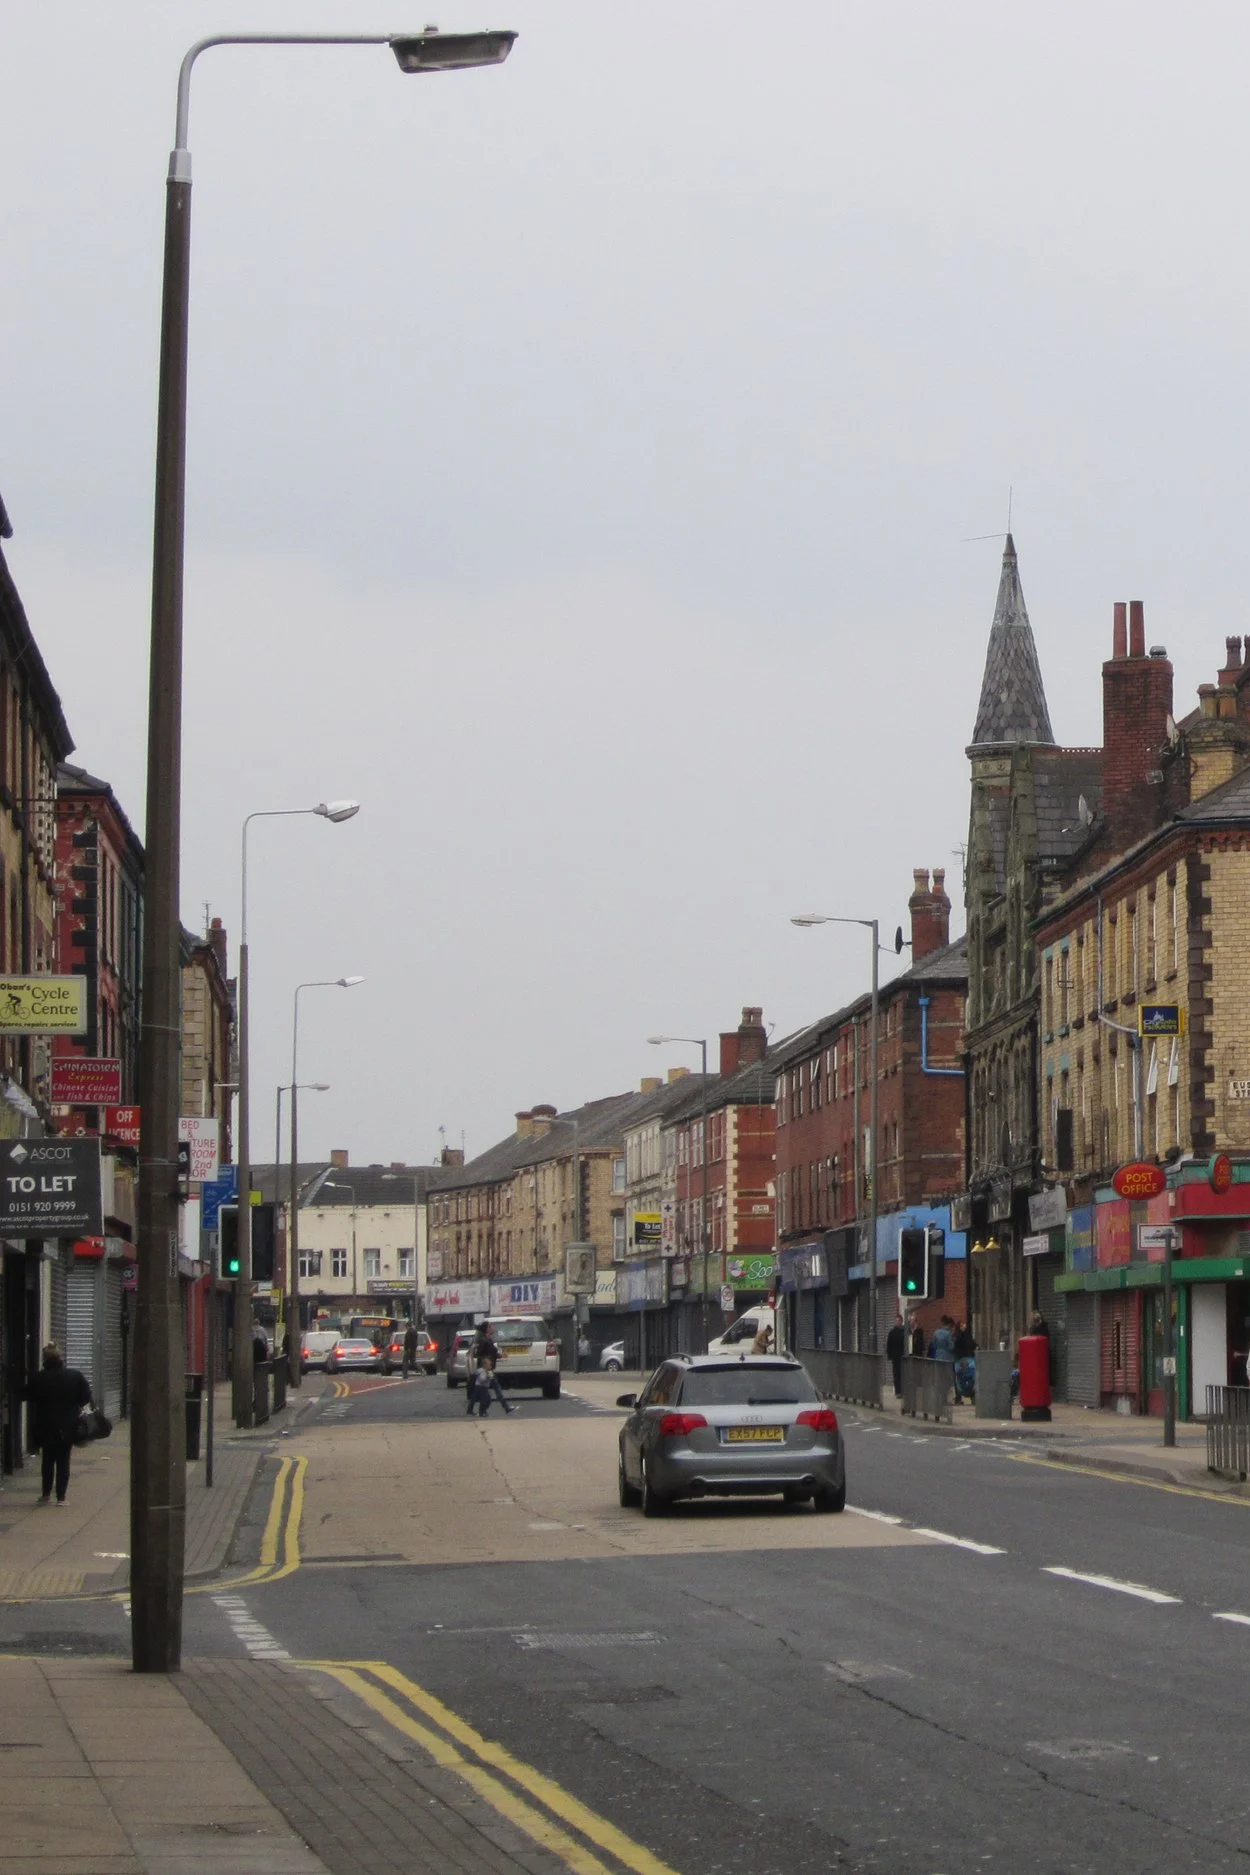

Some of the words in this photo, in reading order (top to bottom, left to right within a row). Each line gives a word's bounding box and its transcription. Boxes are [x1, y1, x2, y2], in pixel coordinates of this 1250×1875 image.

[32, 986, 70, 1001] Cycle
[32, 1002, 78, 1015] Centre
[52, 1062, 120, 1072] CHINATOWN
[68, 1072, 104, 1083] Express
[52, 1081, 84, 1092] Chinese
[87, 1083, 119, 1092] Cuisine
[84, 1093, 91, 1101] &
[93, 1093, 117, 1102] Chips
[116, 1111, 134, 1122] OFF
[181, 1120, 200, 1129] BED
[191, 1139, 216, 1148] TURE
[30, 1147, 72, 1160] ASCOT
[192, 1169, 207, 1178] OR
[1125, 1172, 1154, 1184] POST
[6, 1176, 36, 1193] TO
[41, 1175, 77, 1192] LET
[1121, 1183, 1158, 1195] OFFICE
[9, 1202, 31, 1212] 0151
[34, 1202, 52, 1212] 920
[53, 1201, 77, 1211] 9999
[510, 1283, 540, 1303] DIY
